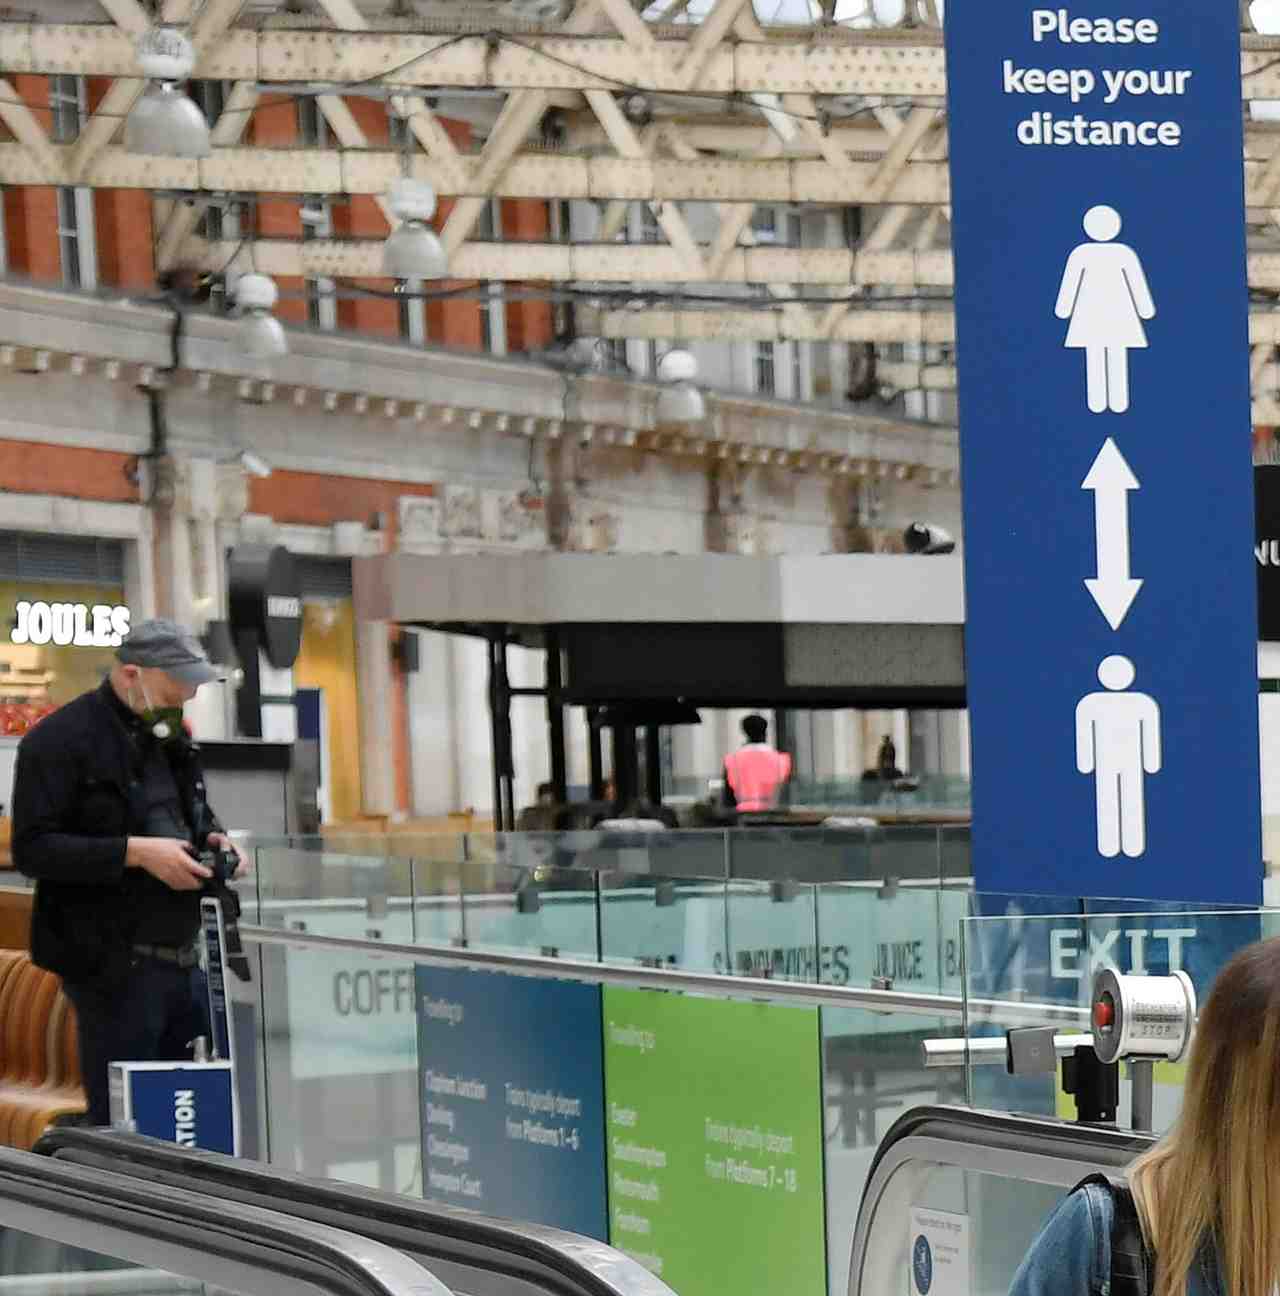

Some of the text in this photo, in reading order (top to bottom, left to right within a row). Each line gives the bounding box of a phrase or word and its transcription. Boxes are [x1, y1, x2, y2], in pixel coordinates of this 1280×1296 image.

[1032, 9, 1158, 43] Please
[1003, 60, 1192, 103] keep your
[1017, 112, 1181, 146] distance
[11, 601, 131, 648] JOULES
[1050, 928, 1198, 979] EXIT
